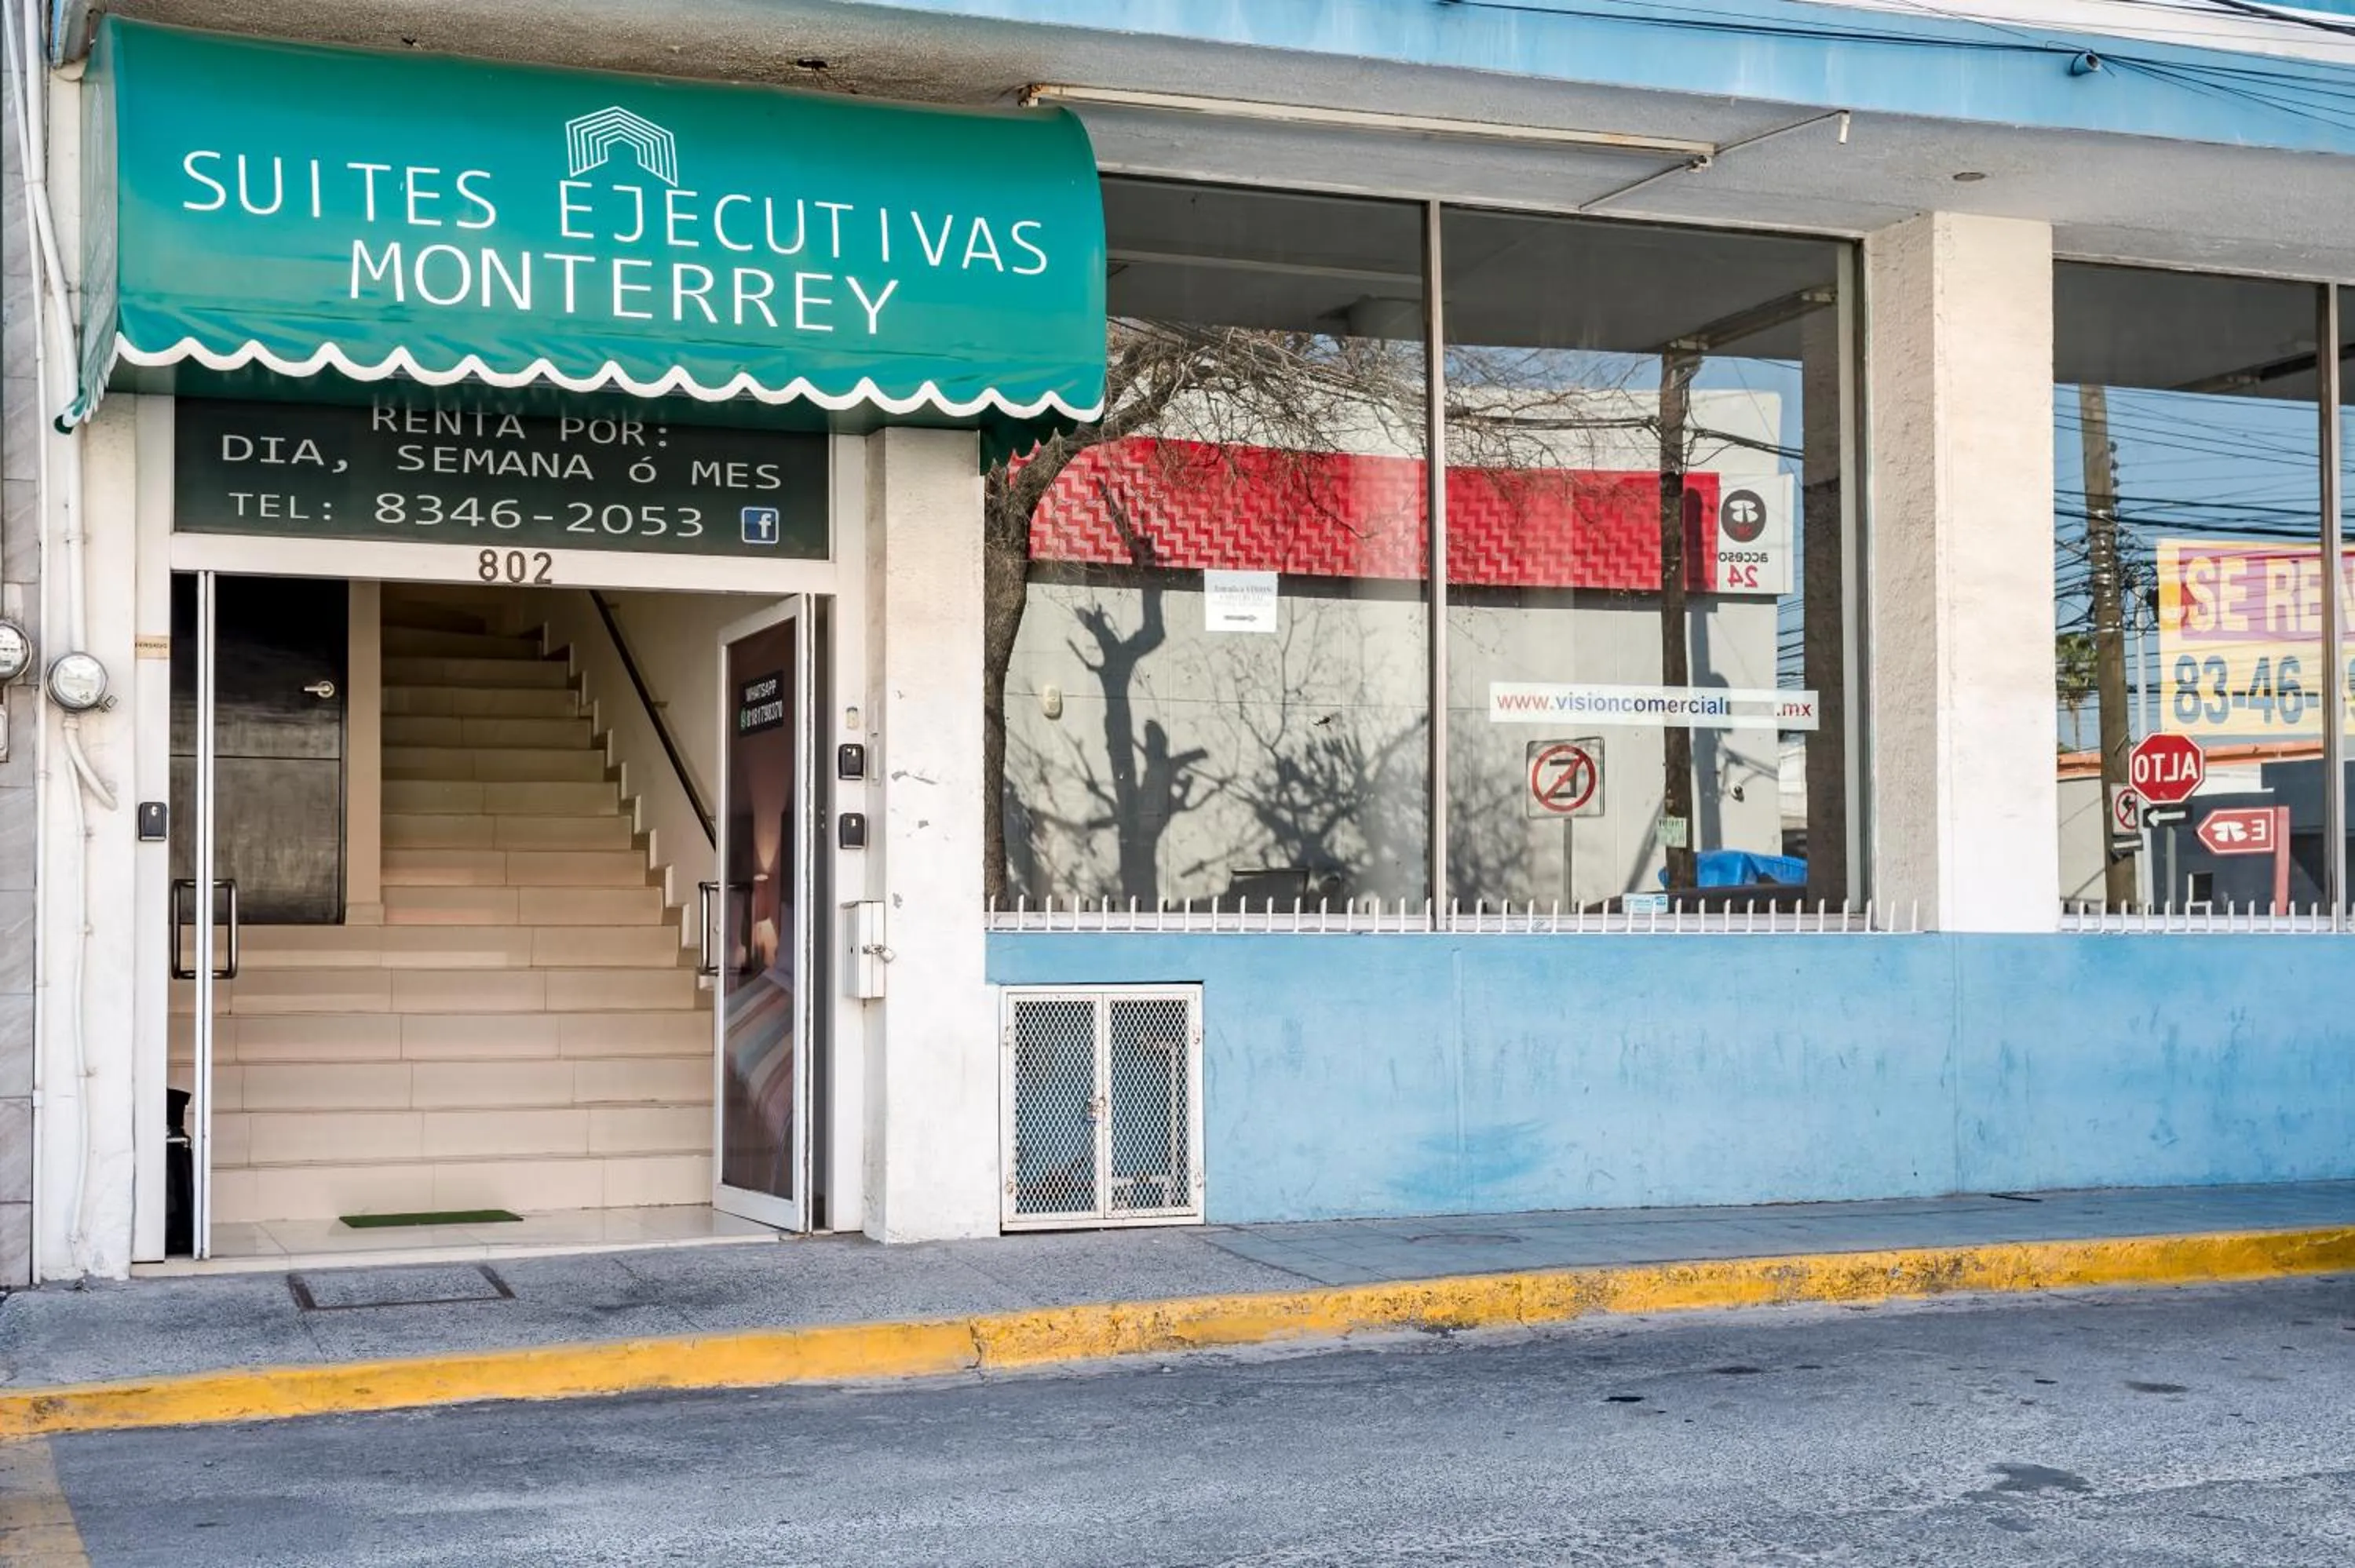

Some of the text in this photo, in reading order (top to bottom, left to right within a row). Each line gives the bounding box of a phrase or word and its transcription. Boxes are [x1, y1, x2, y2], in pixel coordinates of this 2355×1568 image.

[183, 149, 1048, 275] SUITES EJECUTIVAS
[349, 239, 899, 335] MONTERREY
[372, 403, 668, 448] RENTA POR:
[221, 433, 349, 473] DIA,
[396, 444, 595, 481] SEMANA
[691, 460, 782, 490] MES
[228, 492, 704, 538] TEL: 8346-2053
[478, 549, 553, 585] 802
[2185, 555, 2250, 633] SE
[2173, 655, 2355, 725] 83-46-
